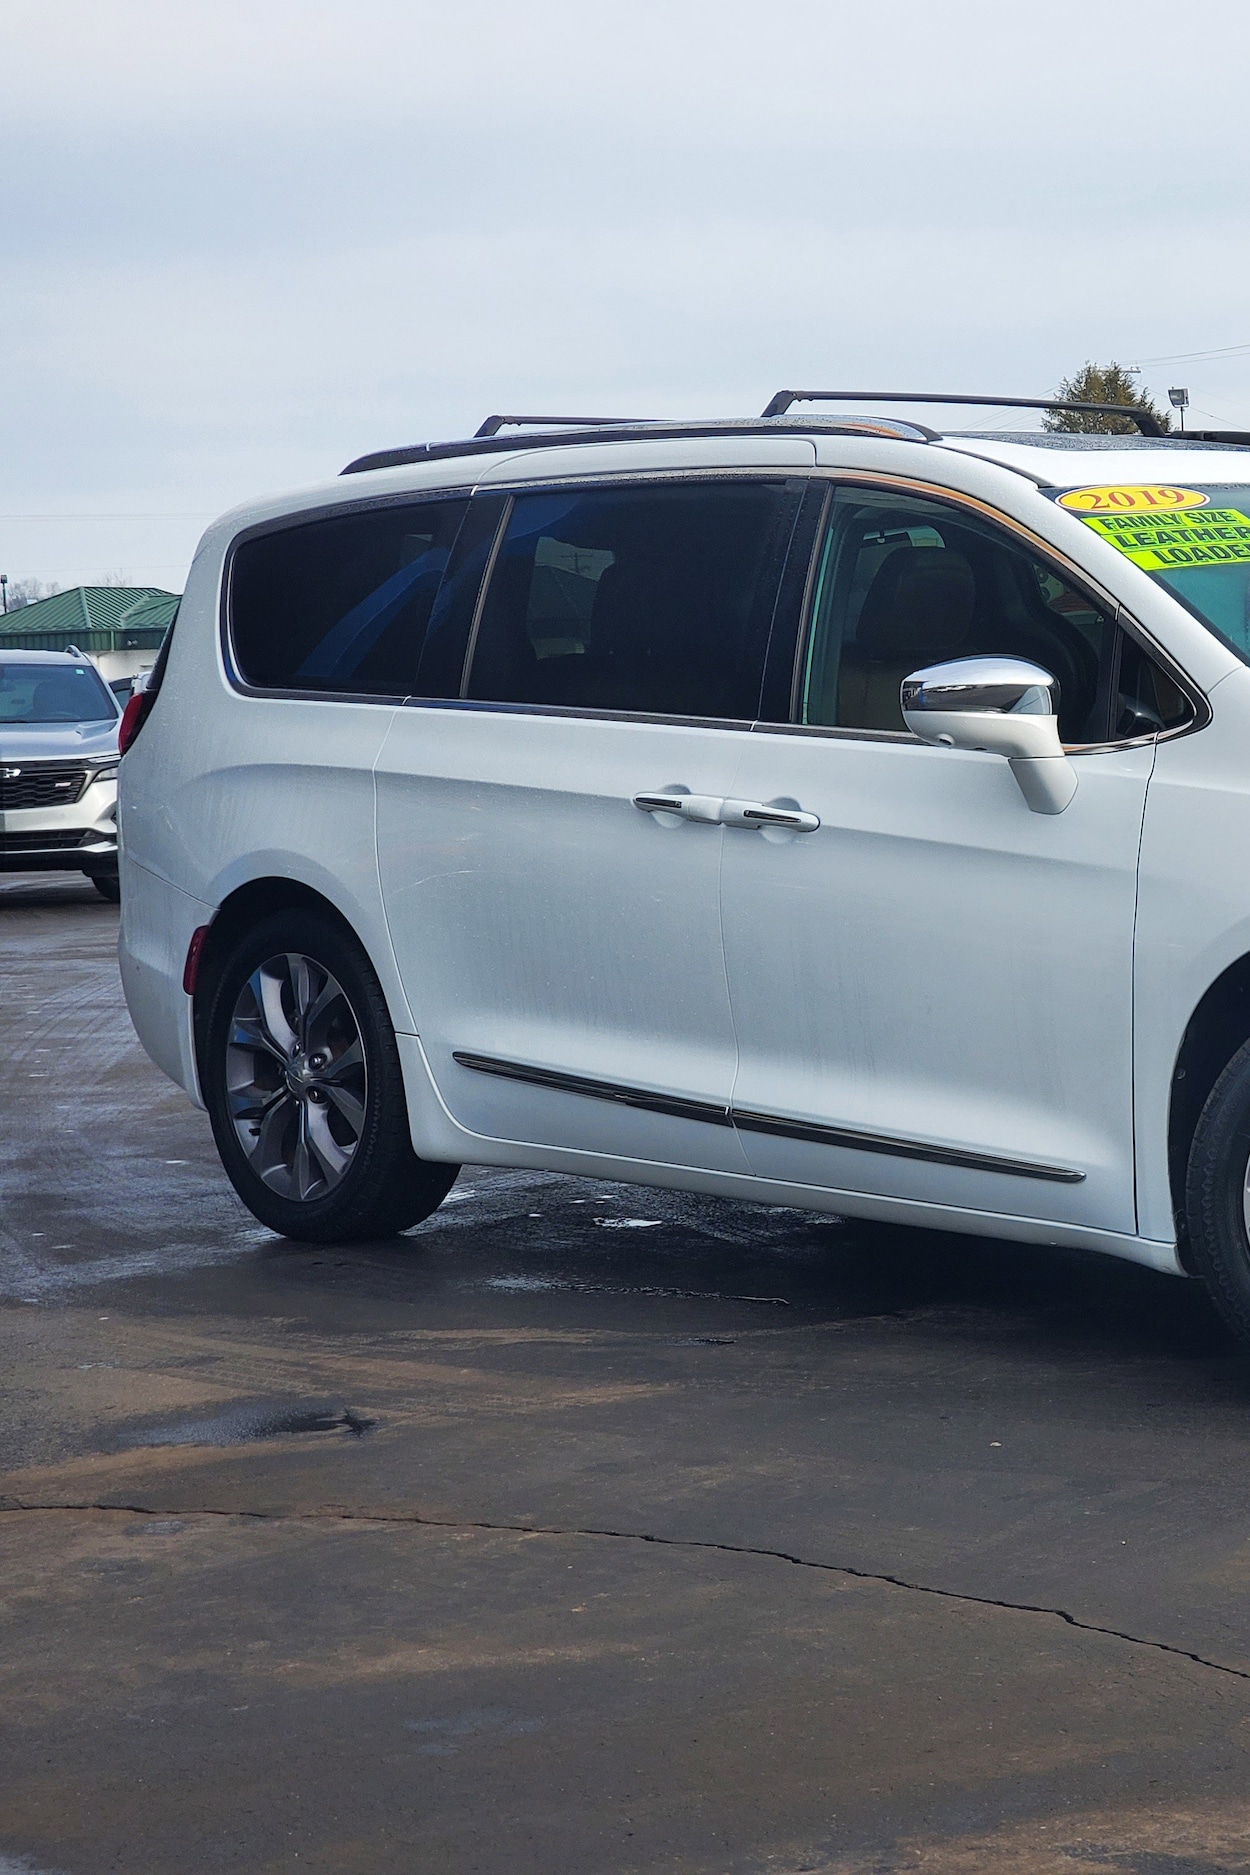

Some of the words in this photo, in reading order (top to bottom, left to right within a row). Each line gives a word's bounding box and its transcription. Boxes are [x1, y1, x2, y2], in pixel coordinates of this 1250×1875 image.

[1079, 488, 1185, 510] 2019
[1099, 512, 1182, 532] FAMILY
[1185, 510, 1238, 525] SIZE
